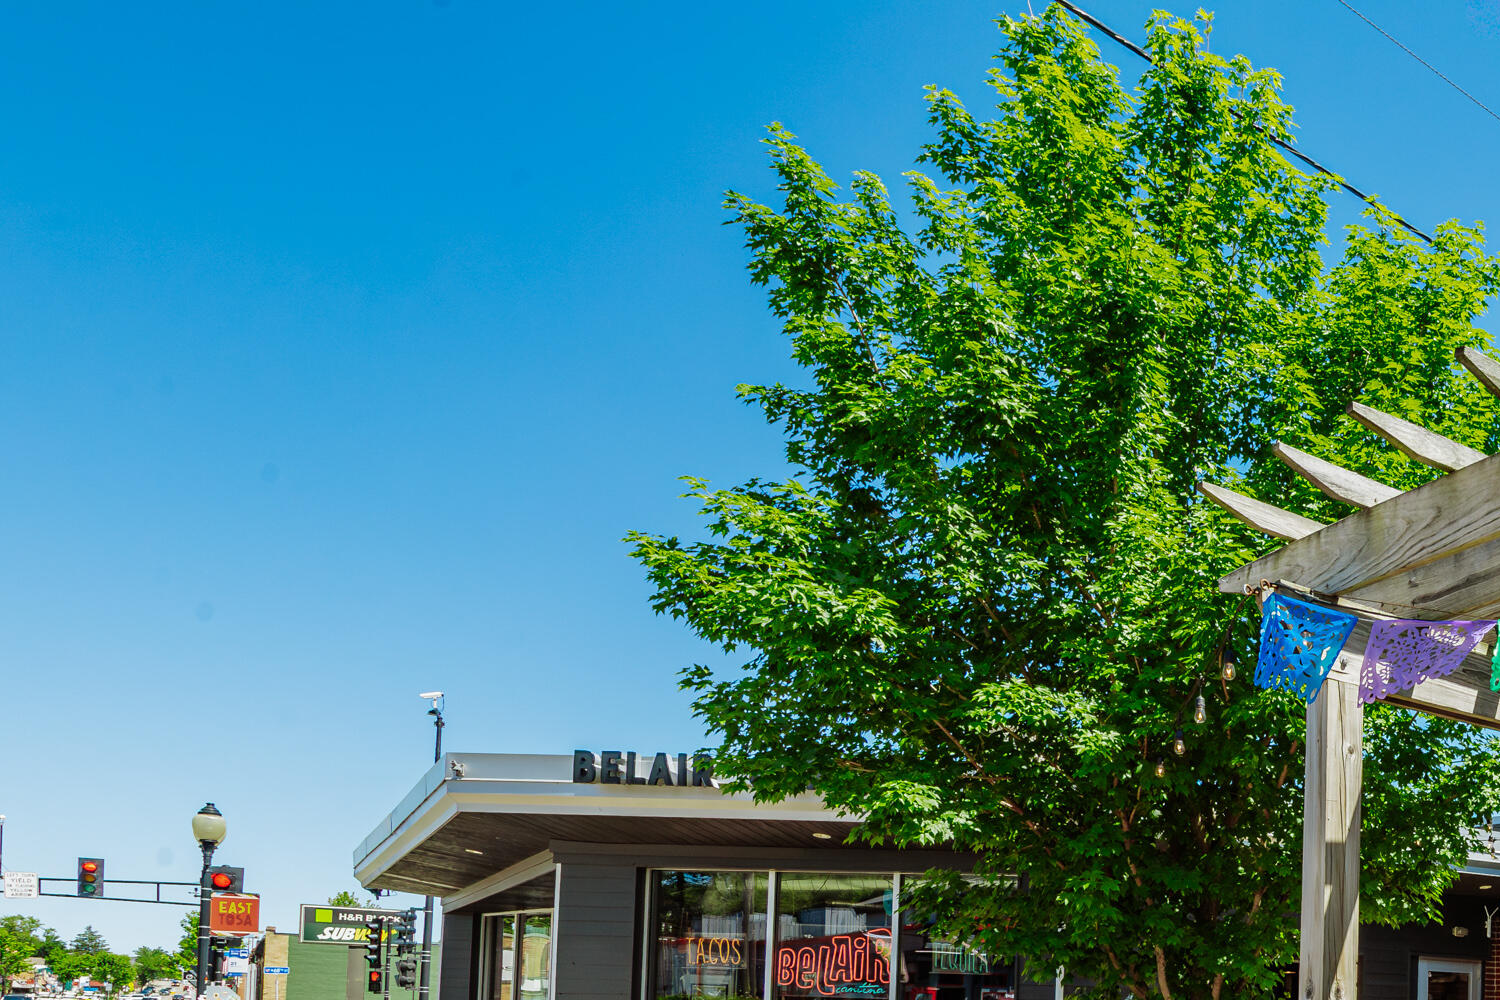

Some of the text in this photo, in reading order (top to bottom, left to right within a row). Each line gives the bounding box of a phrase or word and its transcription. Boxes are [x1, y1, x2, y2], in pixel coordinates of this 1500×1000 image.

[573, 749, 714, 787] BELAIR
[218, 900, 253, 915] EAST
[218, 913, 253, 927] TOSA
[338, 912, 363, 921] H&R
[685, 936, 742, 965] TACOS
